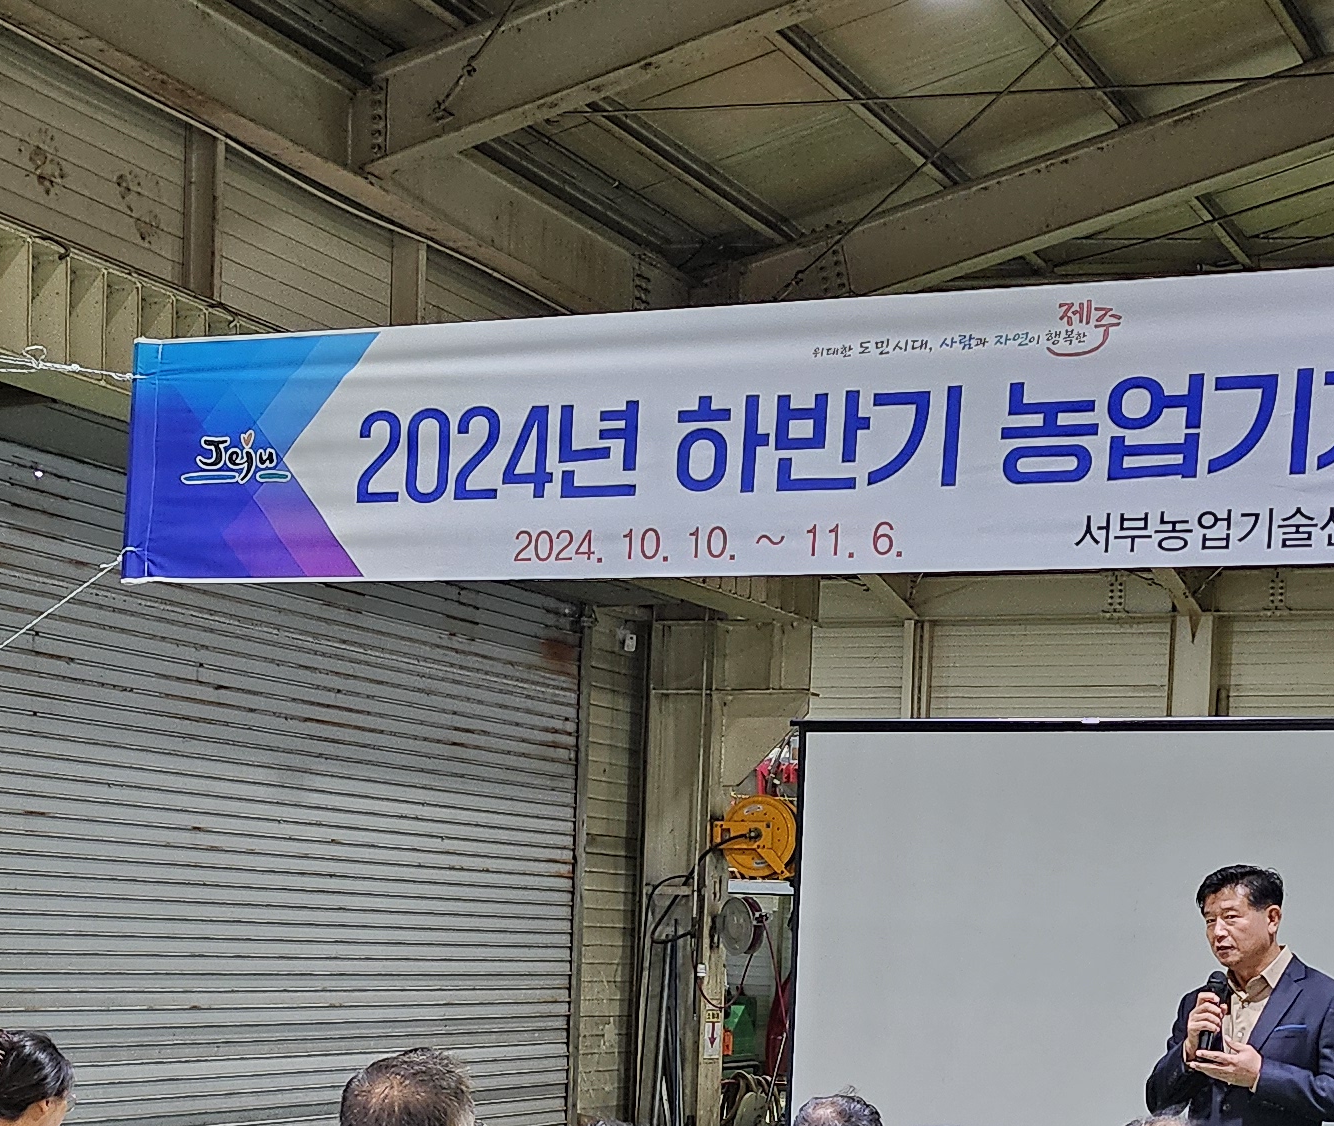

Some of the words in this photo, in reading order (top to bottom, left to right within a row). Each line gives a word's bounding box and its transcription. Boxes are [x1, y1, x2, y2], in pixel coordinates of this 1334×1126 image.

[1058, 299, 1122, 344] 제주
[858, 337, 933, 355] 도민시대,
[939, 333, 989, 350] 사람과
[994, 331, 1041, 347] 자연이
[1045, 329, 1087, 346] 행복한
[812, 344, 854, 358] 위대한
[357, 403, 640, 505] 2024년
[677, 385, 963, 494] 하반기
[196, 430, 277, 485] Jeju
[513, 529, 604, 564] 2024.
[621, 527, 669, 563] 10.
[687, 525, 736, 561] 10.
[806, 522, 855, 559] 11.
[871, 520, 903, 558] 6.
